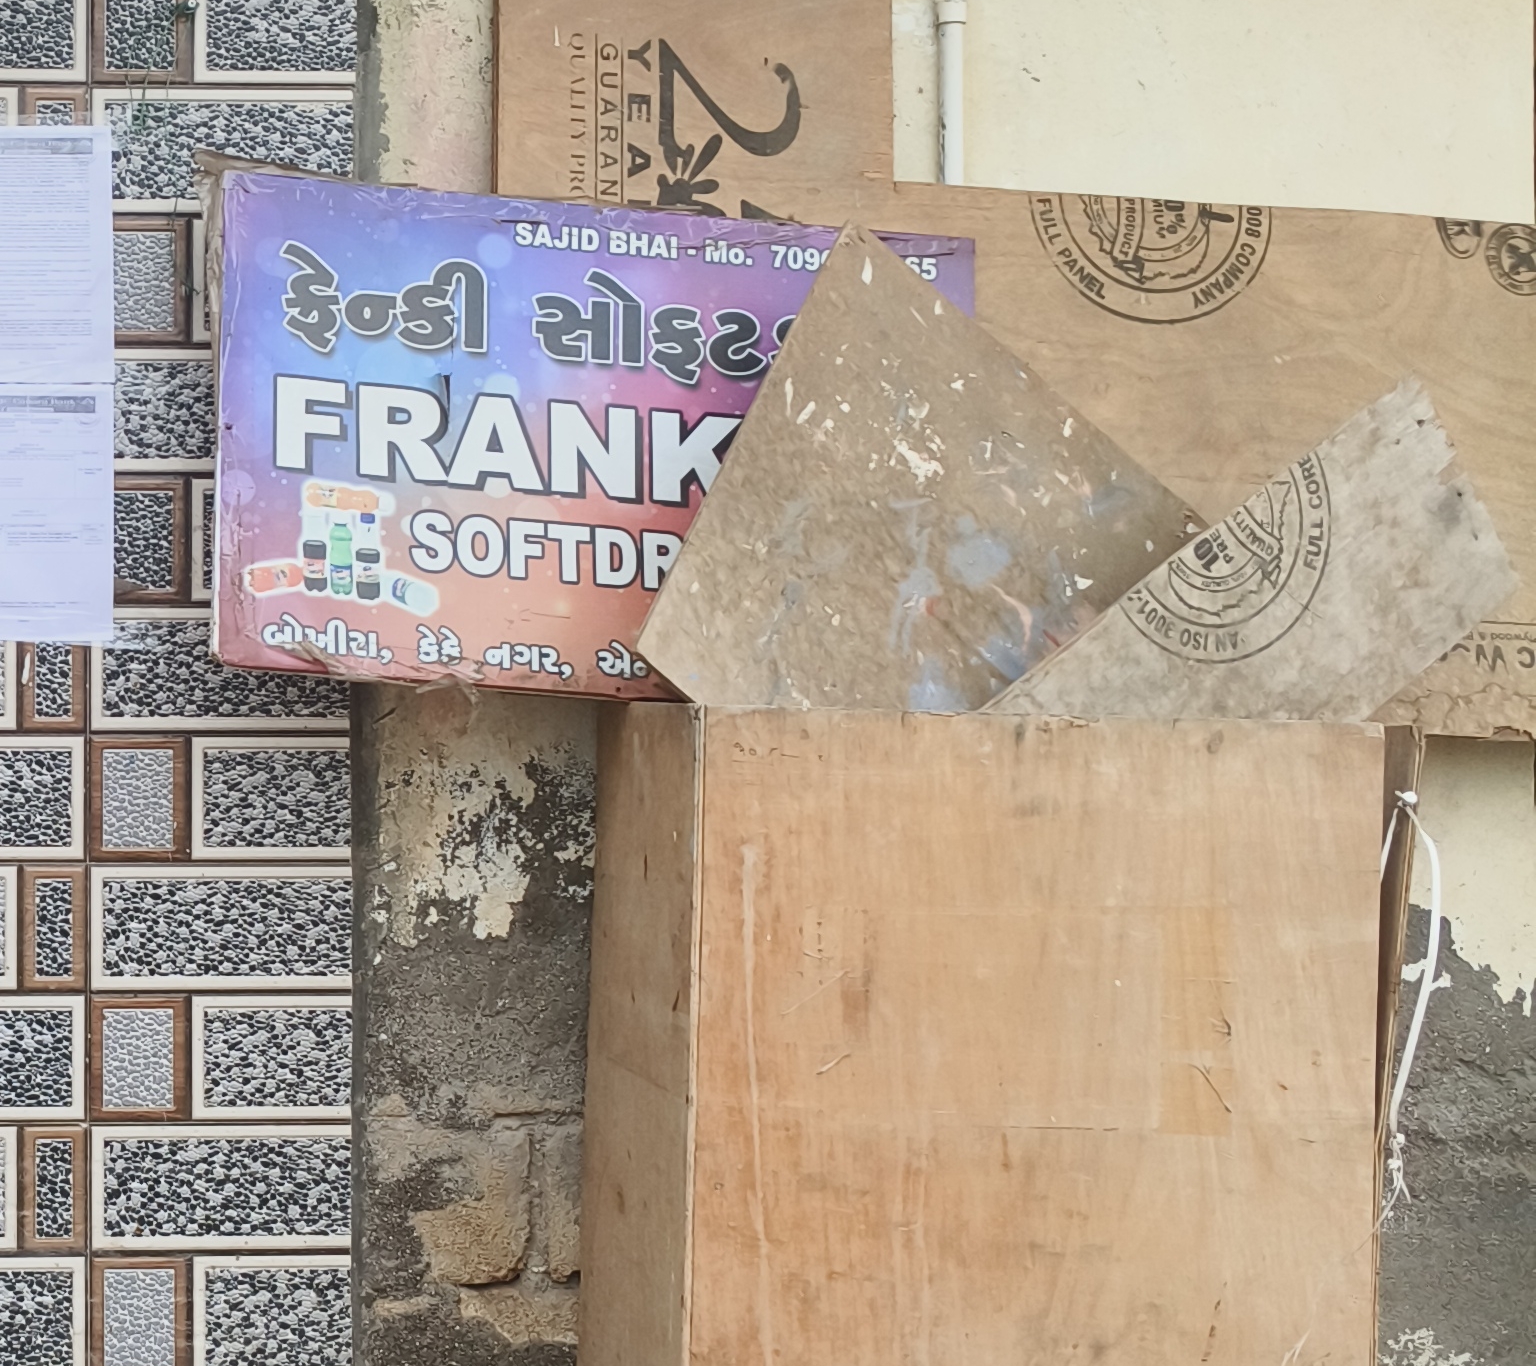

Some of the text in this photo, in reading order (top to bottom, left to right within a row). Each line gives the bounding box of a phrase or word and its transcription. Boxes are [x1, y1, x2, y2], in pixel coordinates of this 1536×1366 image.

[599, 42, 619, 197] GUARAN
[627, 39, 652, 206] YEA
[513, 221, 601, 254] SAJID
[608, 229, 679, 260] BHAI
[702, 239, 755, 267] Mo.
[1035, 197, 1107, 301] FULL PANEL
[1190, 242, 1257, 310] COMPANY
[272, 373, 746, 506] FRANK
[409, 509, 687, 592] SOFTDR
[1208, 528, 1235, 565] PRE
[1231, 509, 1276, 558] QUALITY
[1302, 516, 1325, 572] FULL
[482, 641, 574, 682] નગર,
[1178, 626, 1210, 652] ISO
